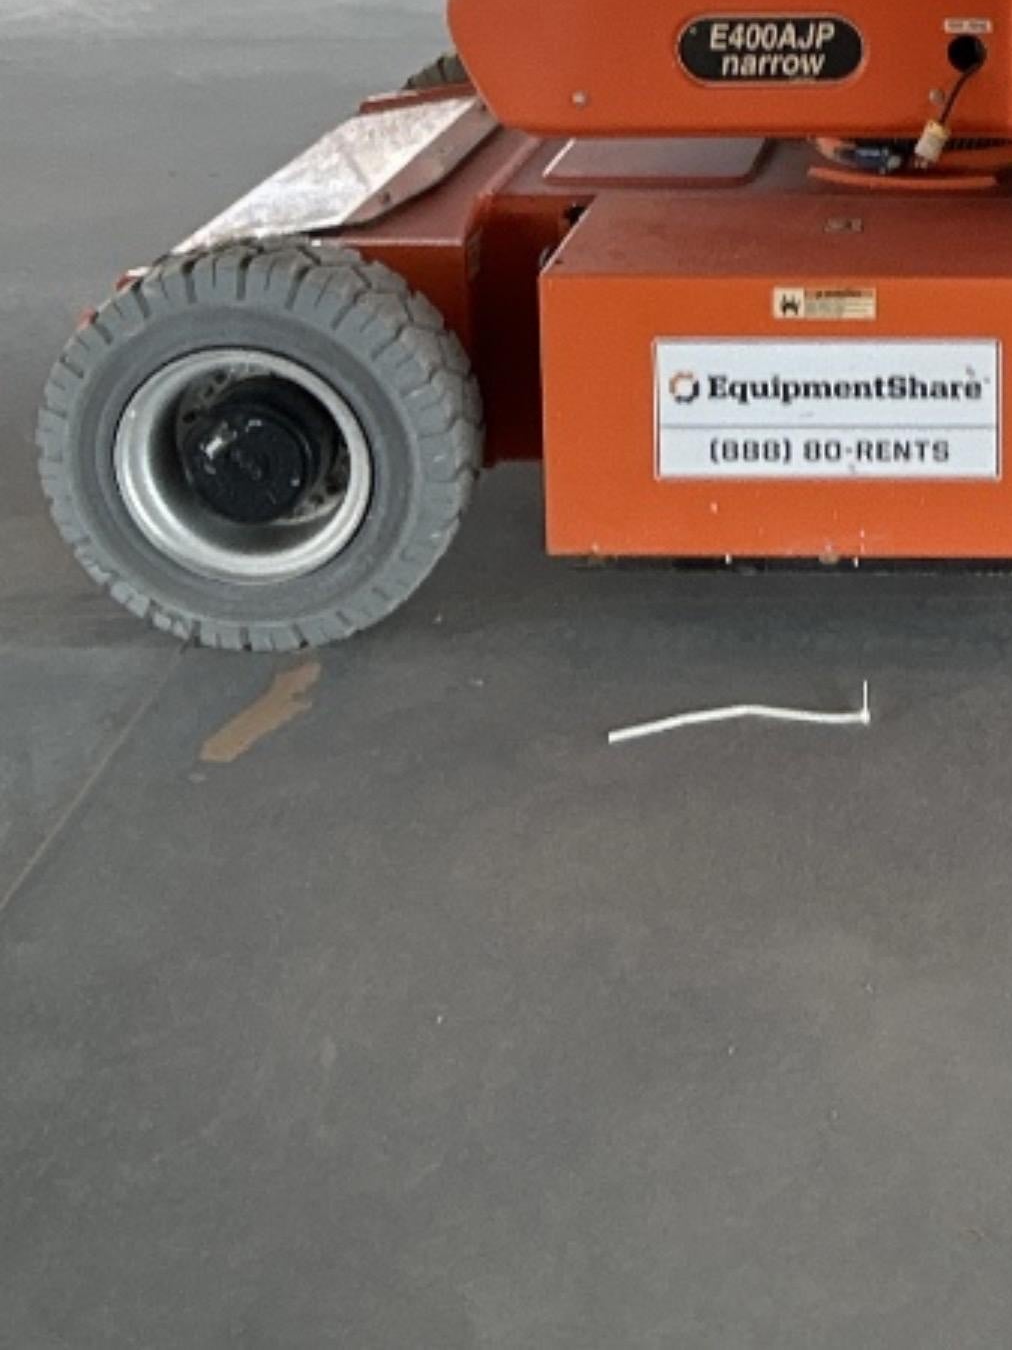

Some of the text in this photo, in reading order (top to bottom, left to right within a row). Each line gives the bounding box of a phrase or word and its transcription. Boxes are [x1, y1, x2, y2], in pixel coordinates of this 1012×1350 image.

[709, 22, 836, 51] E400AJP
[721, 53, 826, 77] narrow
[707, 374, 983, 405] EquipmentShare
